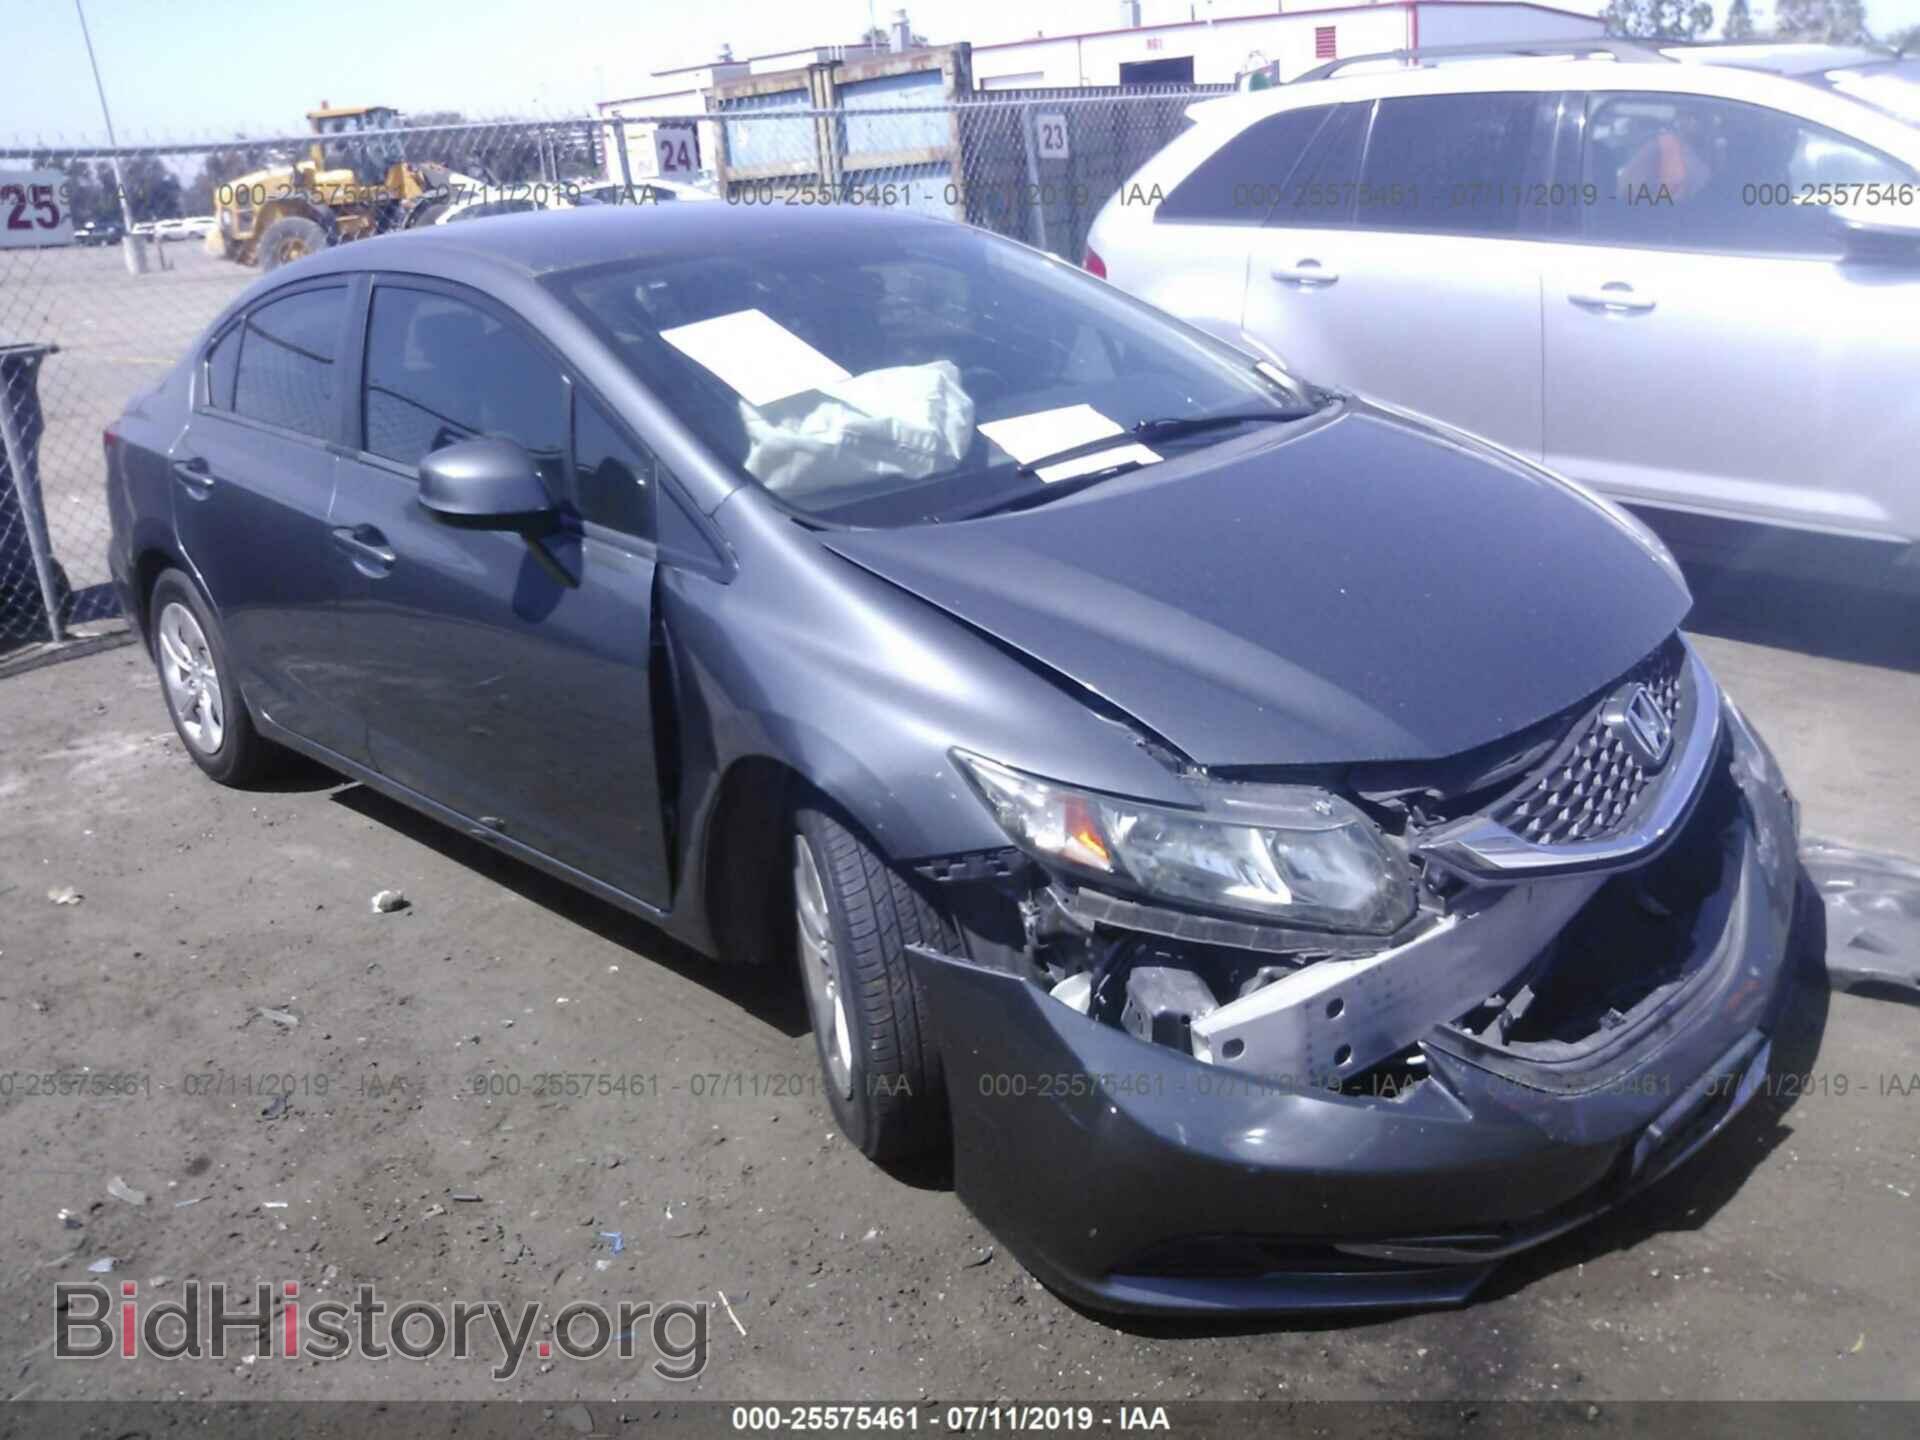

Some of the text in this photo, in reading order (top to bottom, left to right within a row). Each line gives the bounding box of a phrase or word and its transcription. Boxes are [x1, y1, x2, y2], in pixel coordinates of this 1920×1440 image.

[1043, 123, 1064, 150] 23
[661, 140, 691, 171] 24
[3, 184, 61, 230] 25
